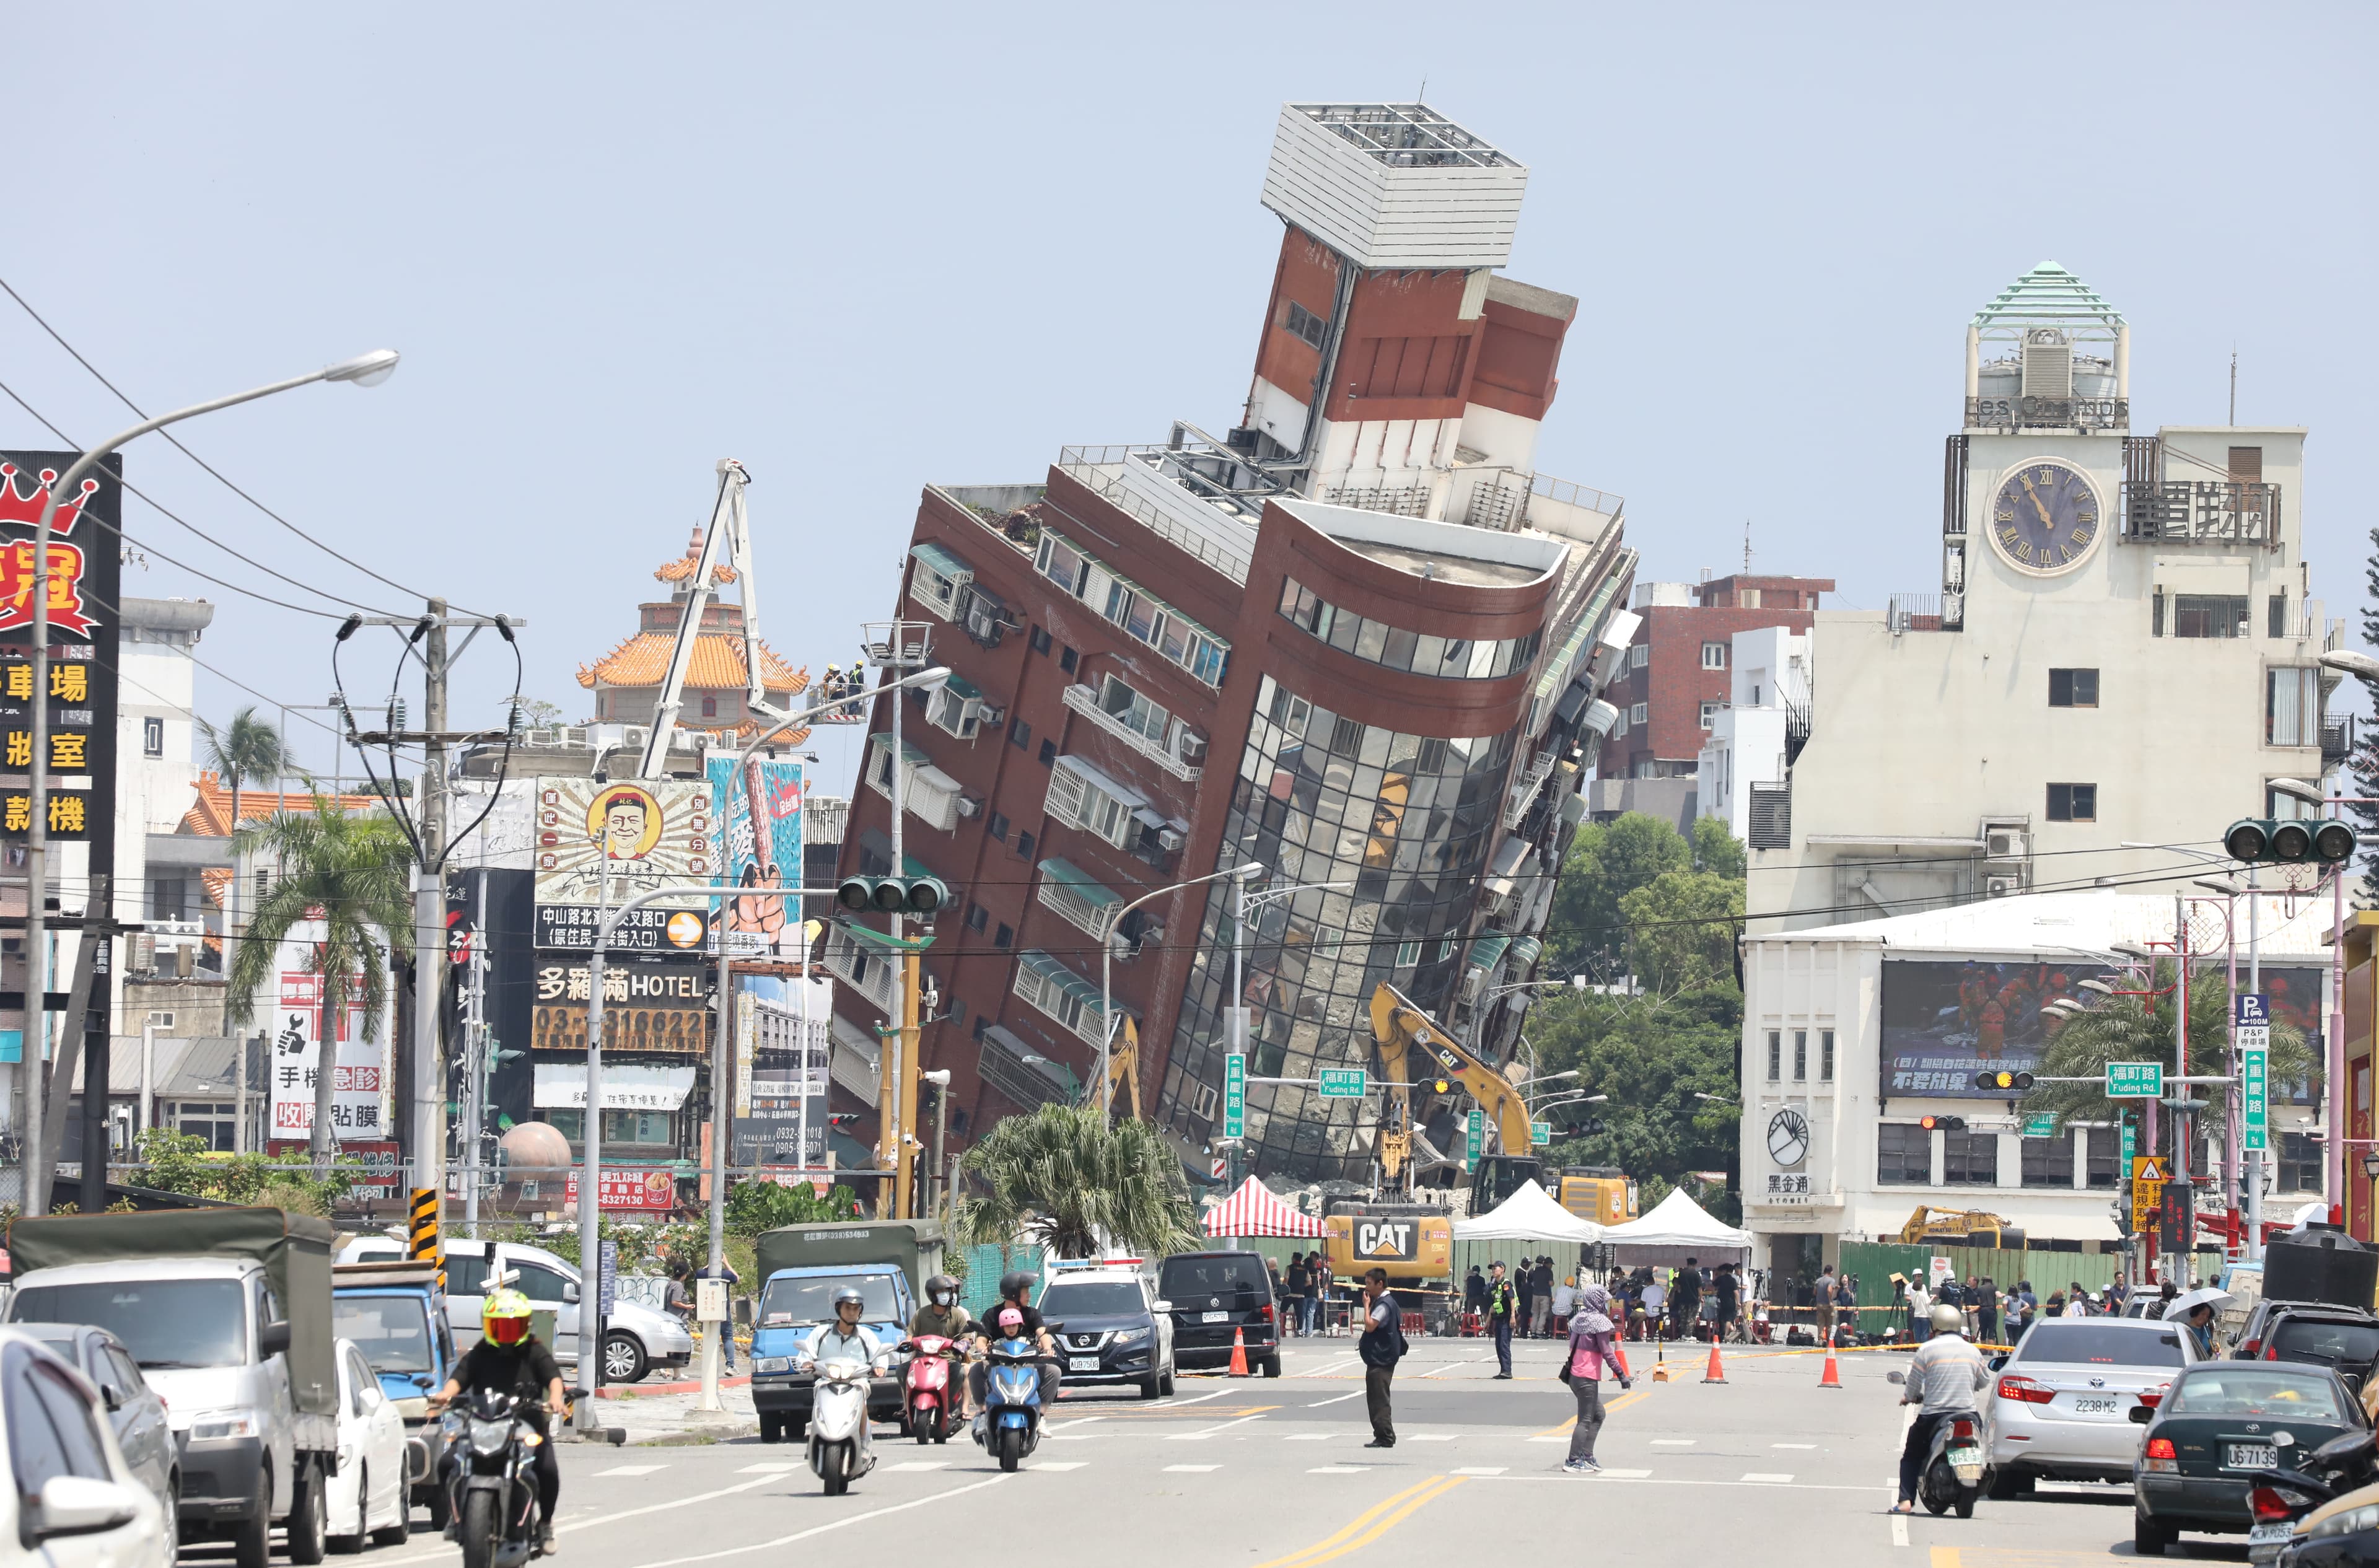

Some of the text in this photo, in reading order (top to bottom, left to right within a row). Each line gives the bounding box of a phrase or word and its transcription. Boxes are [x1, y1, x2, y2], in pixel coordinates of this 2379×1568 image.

[0, 546, 76, 610] 冠
[0, 665, 87, 702] 車場
[543, 792, 557, 867] 僅此一家
[691, 798, 705, 872] 別無分號
[537, 967, 703, 1002] 多羅滿 HOTEL
[2244, 996, 2258, 1017] P
[536, 1008, 701, 1033] 03-316622
[2241, 1038, 2266, 1046] 停車場
[1439, 1049, 1458, 1067] CAT
[1325, 1072, 1360, 1084] 福町路
[1893, 1071, 1968, 1090] 不要放棄
[2113, 1067, 2155, 1080] 福町路
[1229, 1066, 1241, 1108] 重慶路
[1325, 1085, 1347, 1095] Fuding
[2113, 1084, 2156, 1093] Fuding Rd.
[2248, 1064, 2263, 1113] 重慶路
[776, 1126, 823, 1140] 0932-1018
[1470, 1119, 1480, 1152] 花崗街
[2125, 1127, 2134, 1151] 崗街
[2251, 1136, 2259, 1145] Rd.
[567, 1171, 644, 1183] 胖美式炸雞
[1768, 1175, 1808, 1193] 黑金通
[1546, 1185, 1558, 1199] AT
[1359, 1224, 1411, 1256] CAT
